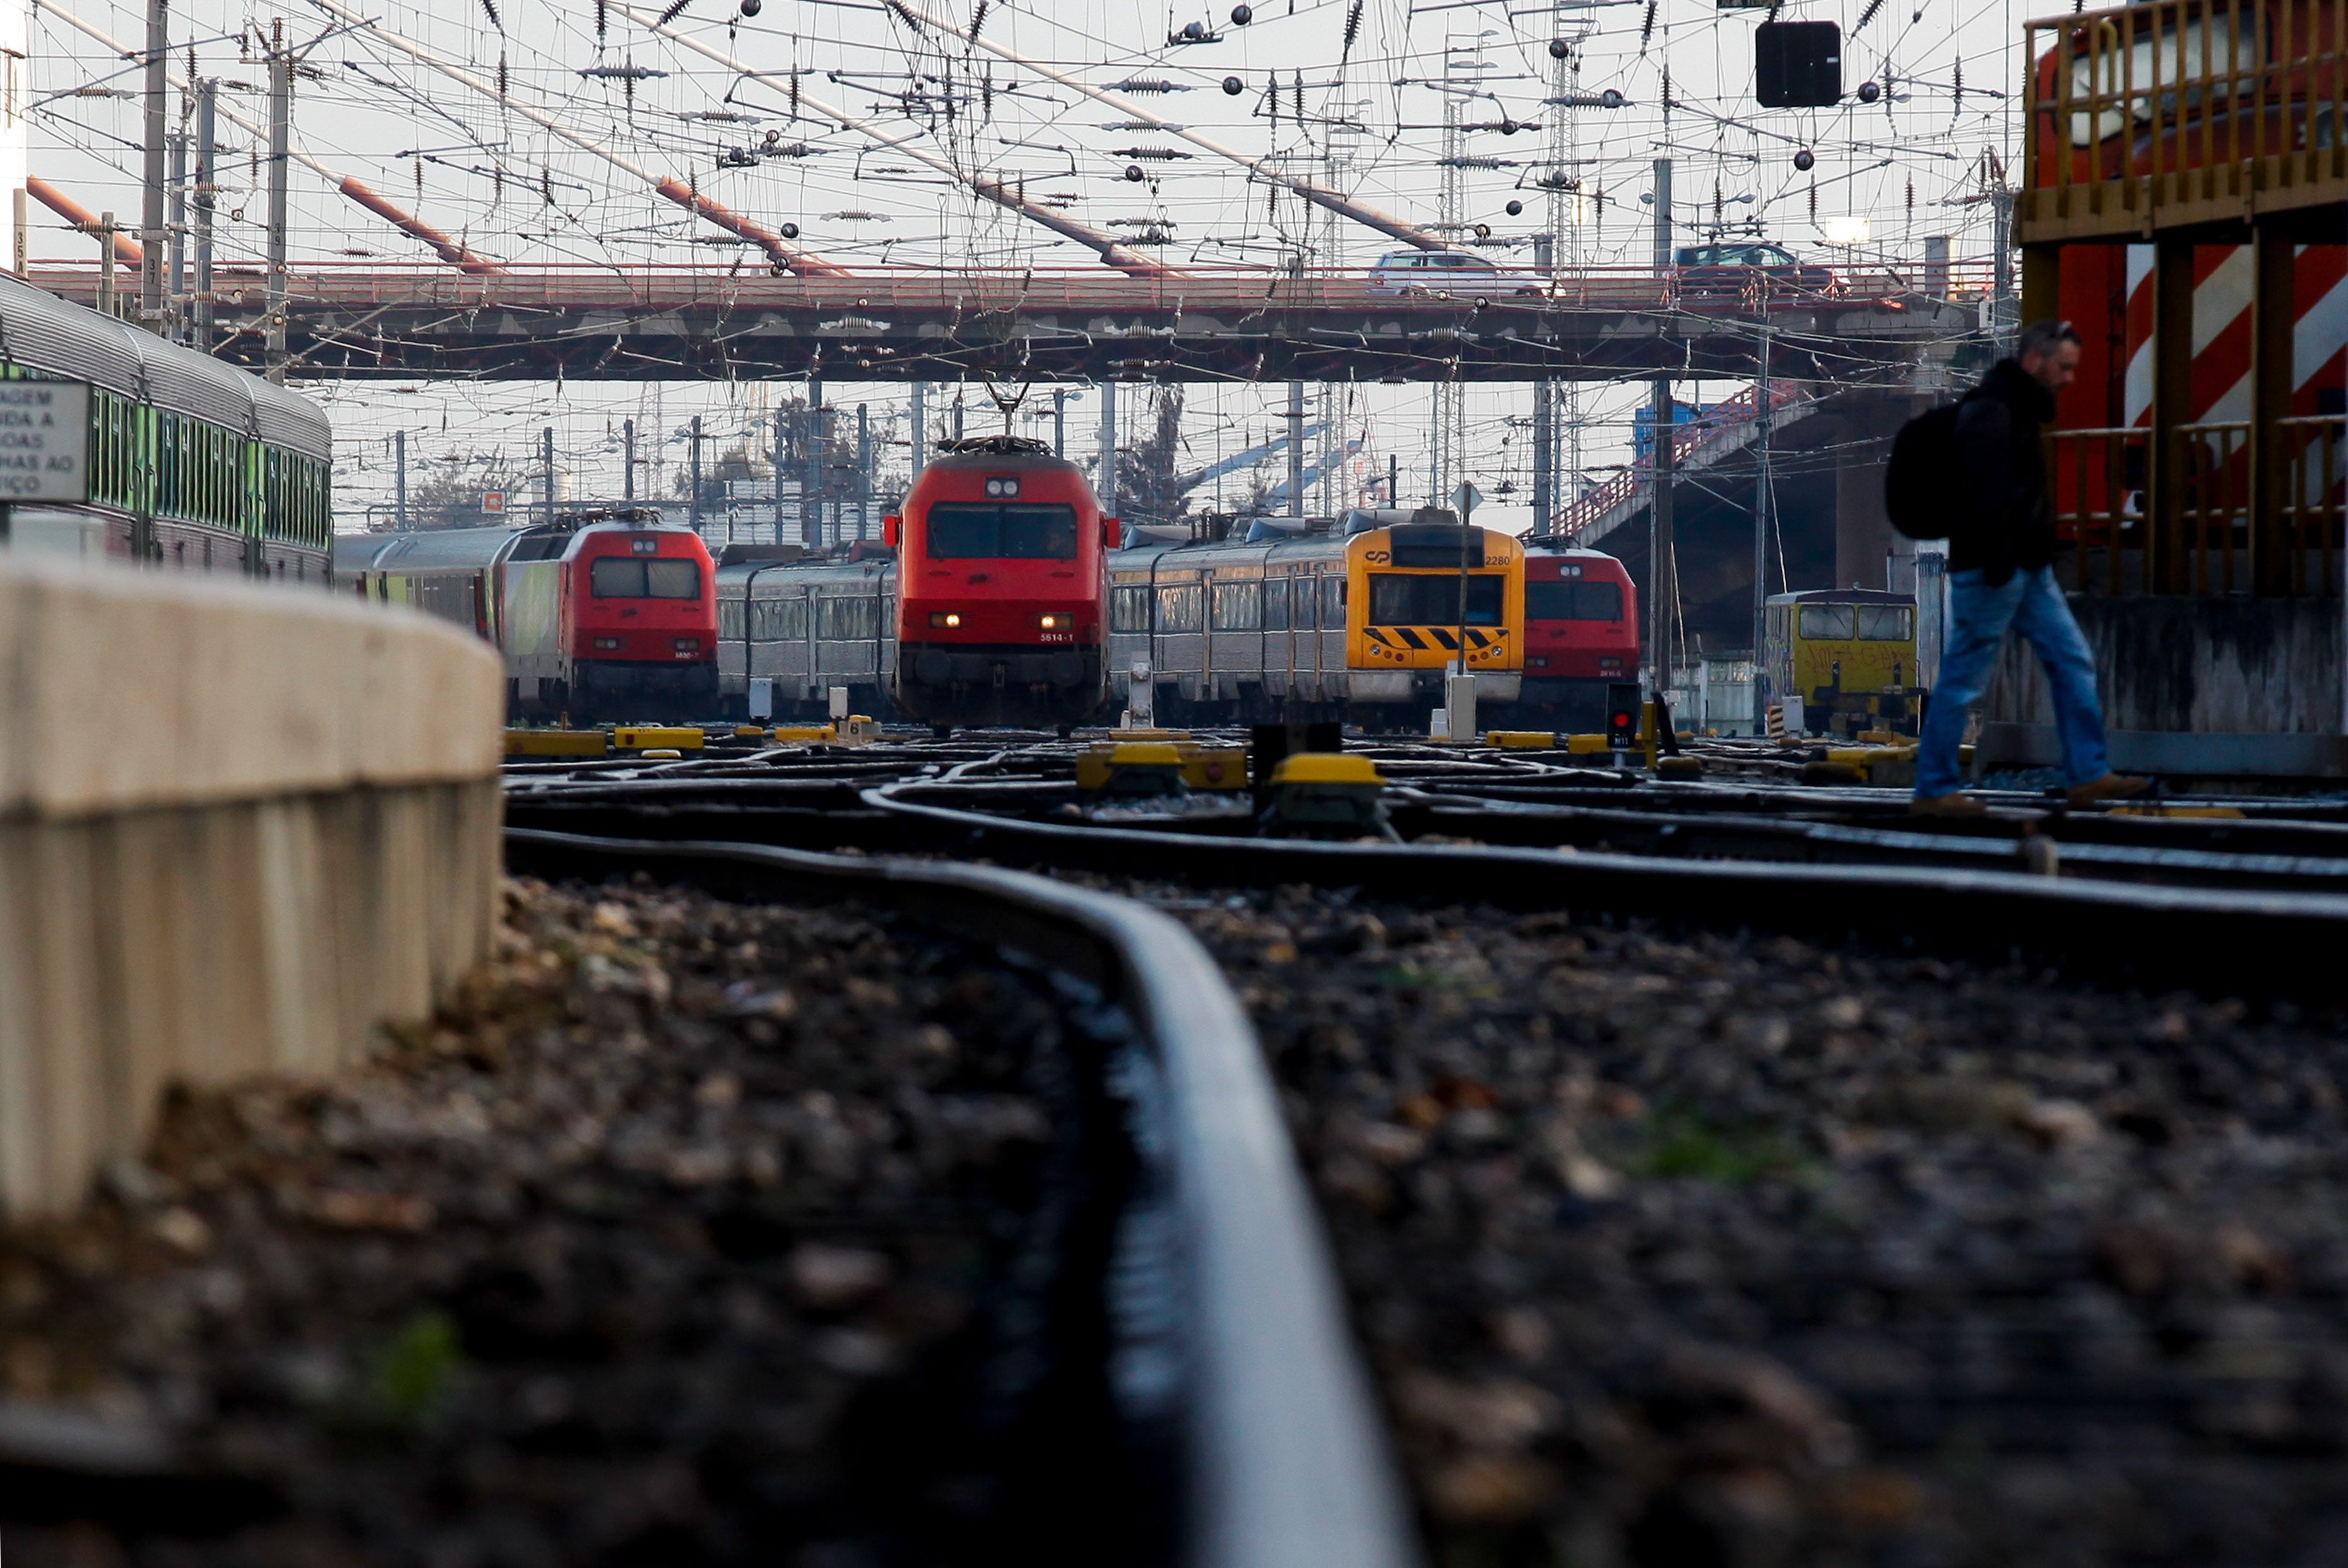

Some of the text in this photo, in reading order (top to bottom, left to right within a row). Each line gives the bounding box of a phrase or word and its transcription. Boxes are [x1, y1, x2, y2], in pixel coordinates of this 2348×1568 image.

[149, 258, 155, 283] 37
[39, 412, 55, 428] A
[45, 455, 75, 473] AO
[1365, 550, 1390, 564] CP
[1485, 556, 1510, 566] 2280
[850, 723, 858, 735] 6
